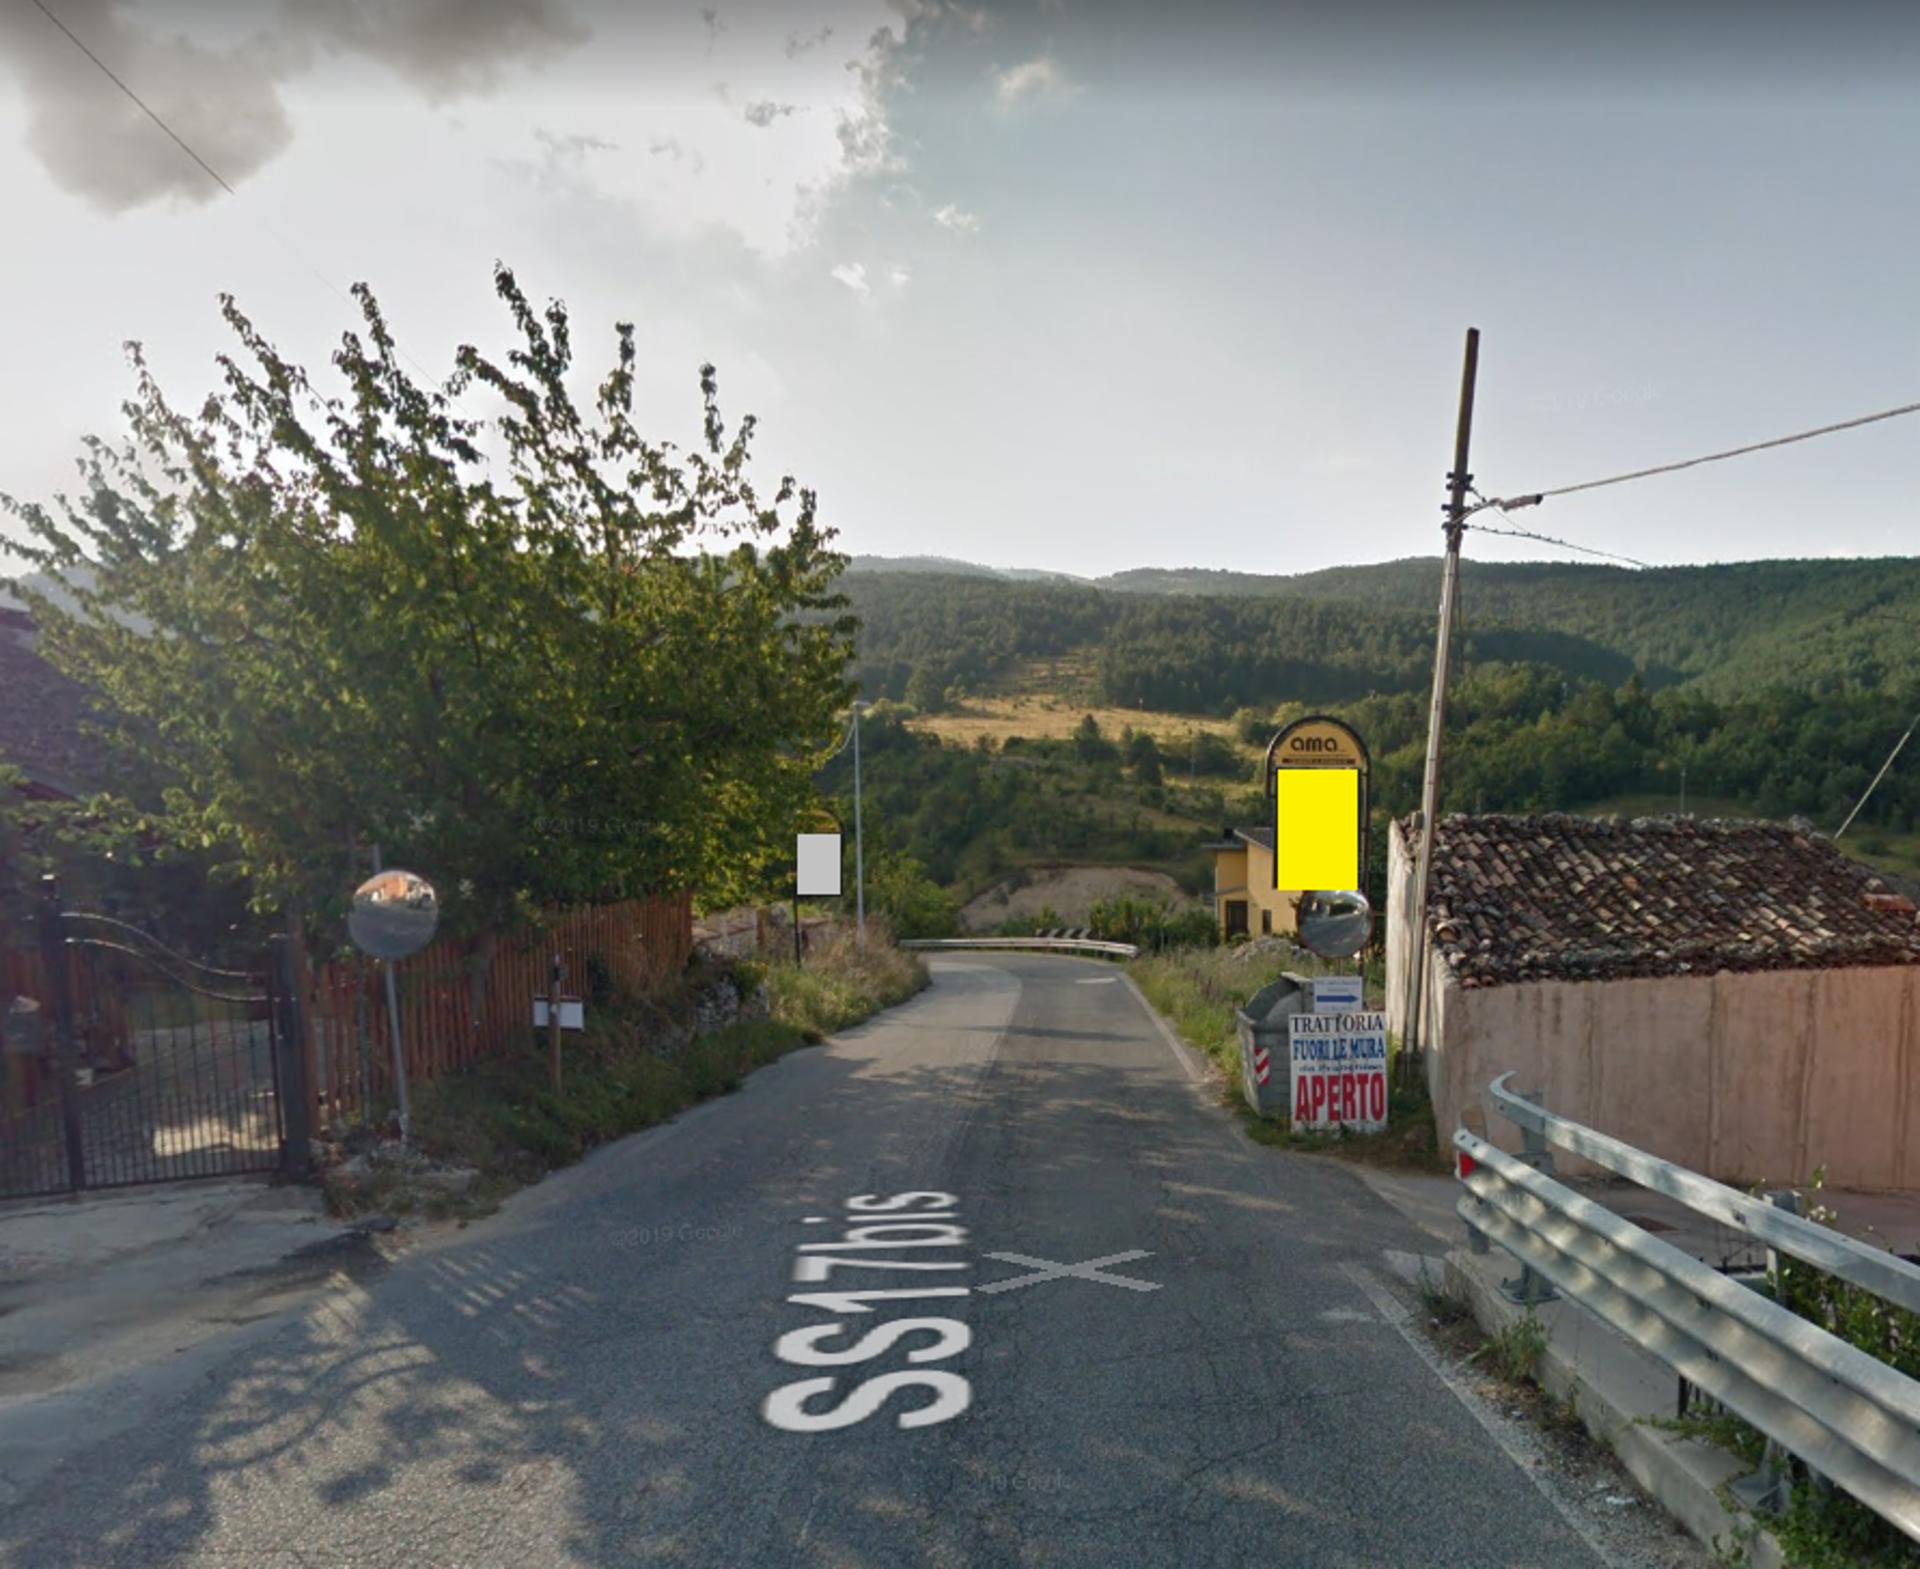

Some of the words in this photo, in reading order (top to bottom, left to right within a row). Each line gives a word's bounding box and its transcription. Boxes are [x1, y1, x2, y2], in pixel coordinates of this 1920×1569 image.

[1290, 736, 1338, 752] ama
[1292, 1013, 1384, 1033] TRATTORIA
[1293, 1038, 1330, 1060] FUORI
[1333, 1038, 1347, 1060] LE
[1350, 1036, 1385, 1059] MURA
[1295, 1071, 1384, 1121] APERTO
